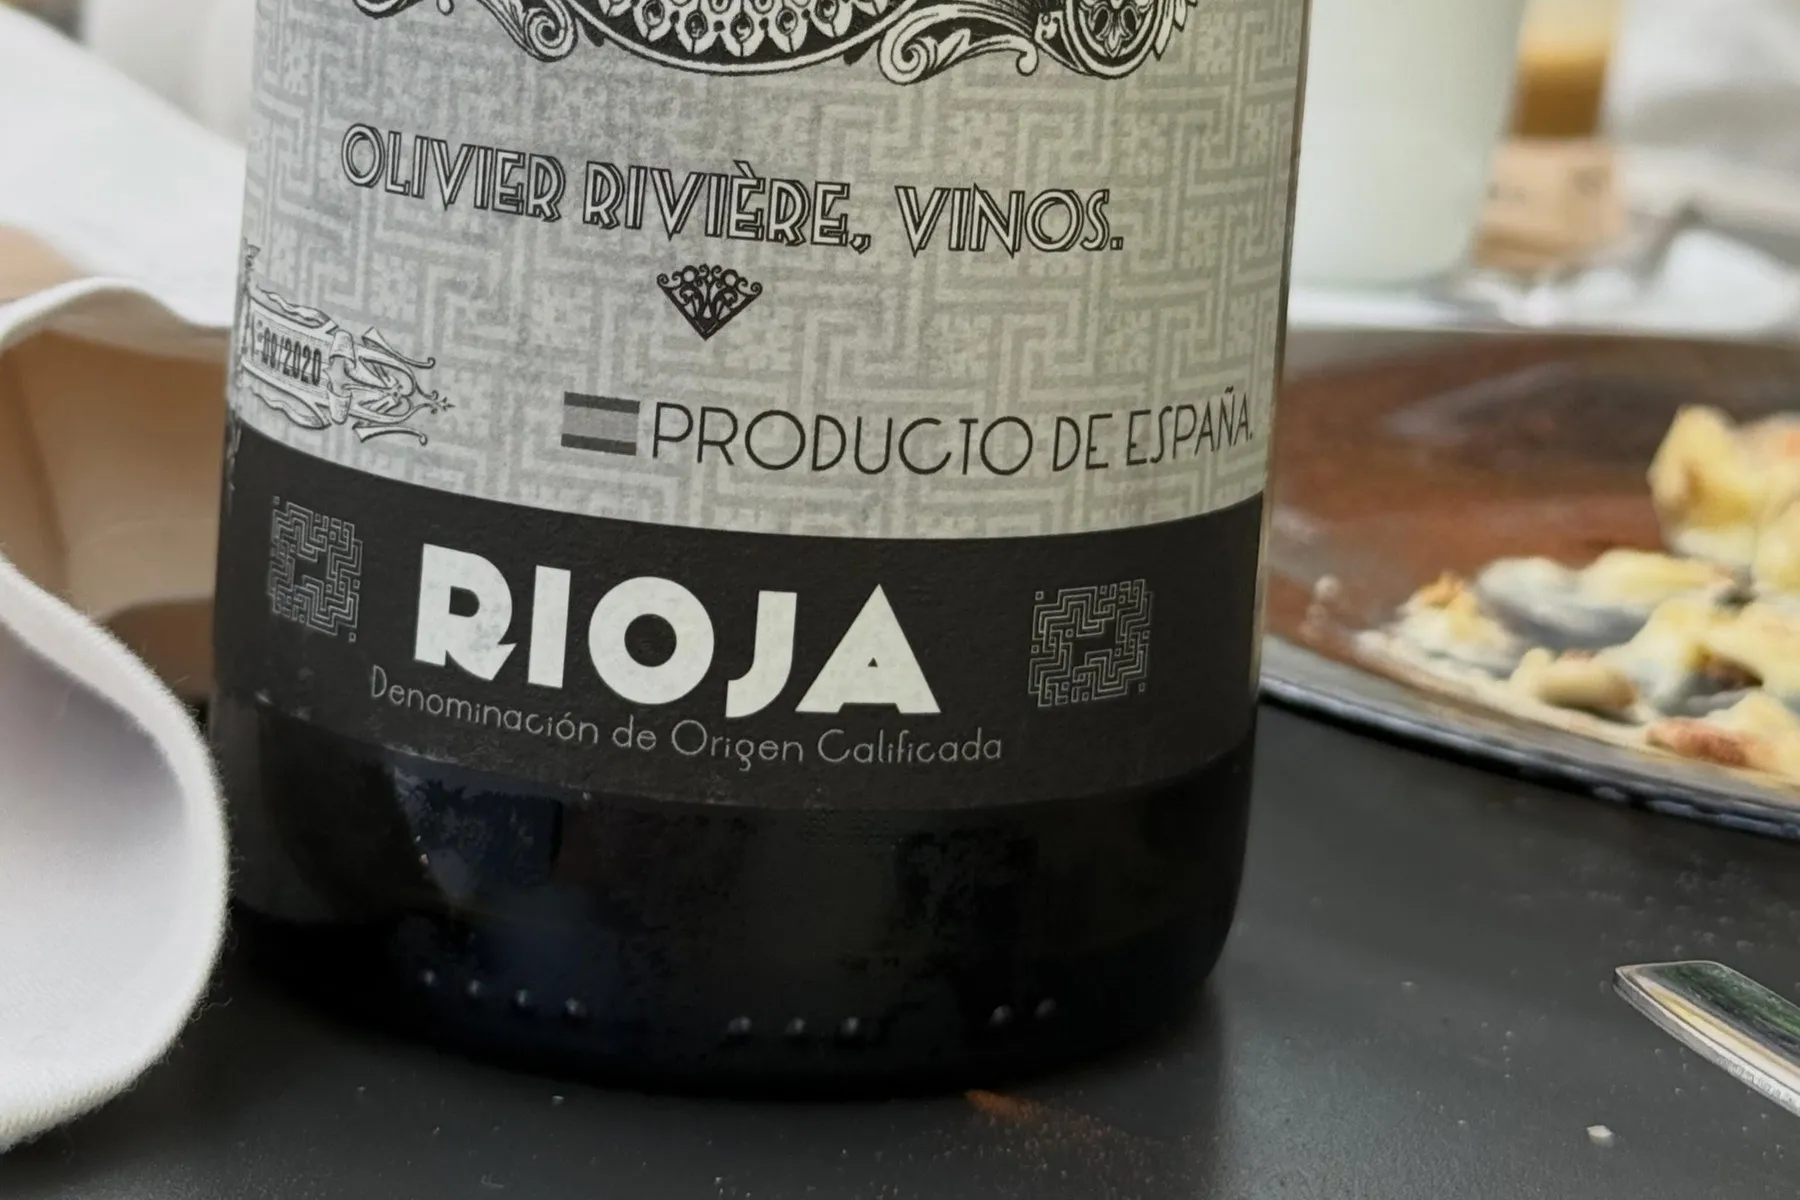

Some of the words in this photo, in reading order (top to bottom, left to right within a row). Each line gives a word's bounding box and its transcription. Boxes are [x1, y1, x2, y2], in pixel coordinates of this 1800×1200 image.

[341, 123, 566, 222] OLIVIER
[583, 160, 871, 254] RIVIÈRE,
[895, 183, 1124, 258] VINOS.
[652, 401, 1034, 476] PRODUCTO
[1052, 414, 1114, 471] DE
[1126, 386, 1254, 467] ESPAÑA.
[414, 543, 942, 719] RIOJA
[370, 664, 599, 745] Denominación
[612, 715, 657, 751] de
[671, 719, 804, 771] Origen
[818, 727, 1002, 764] Calificada
